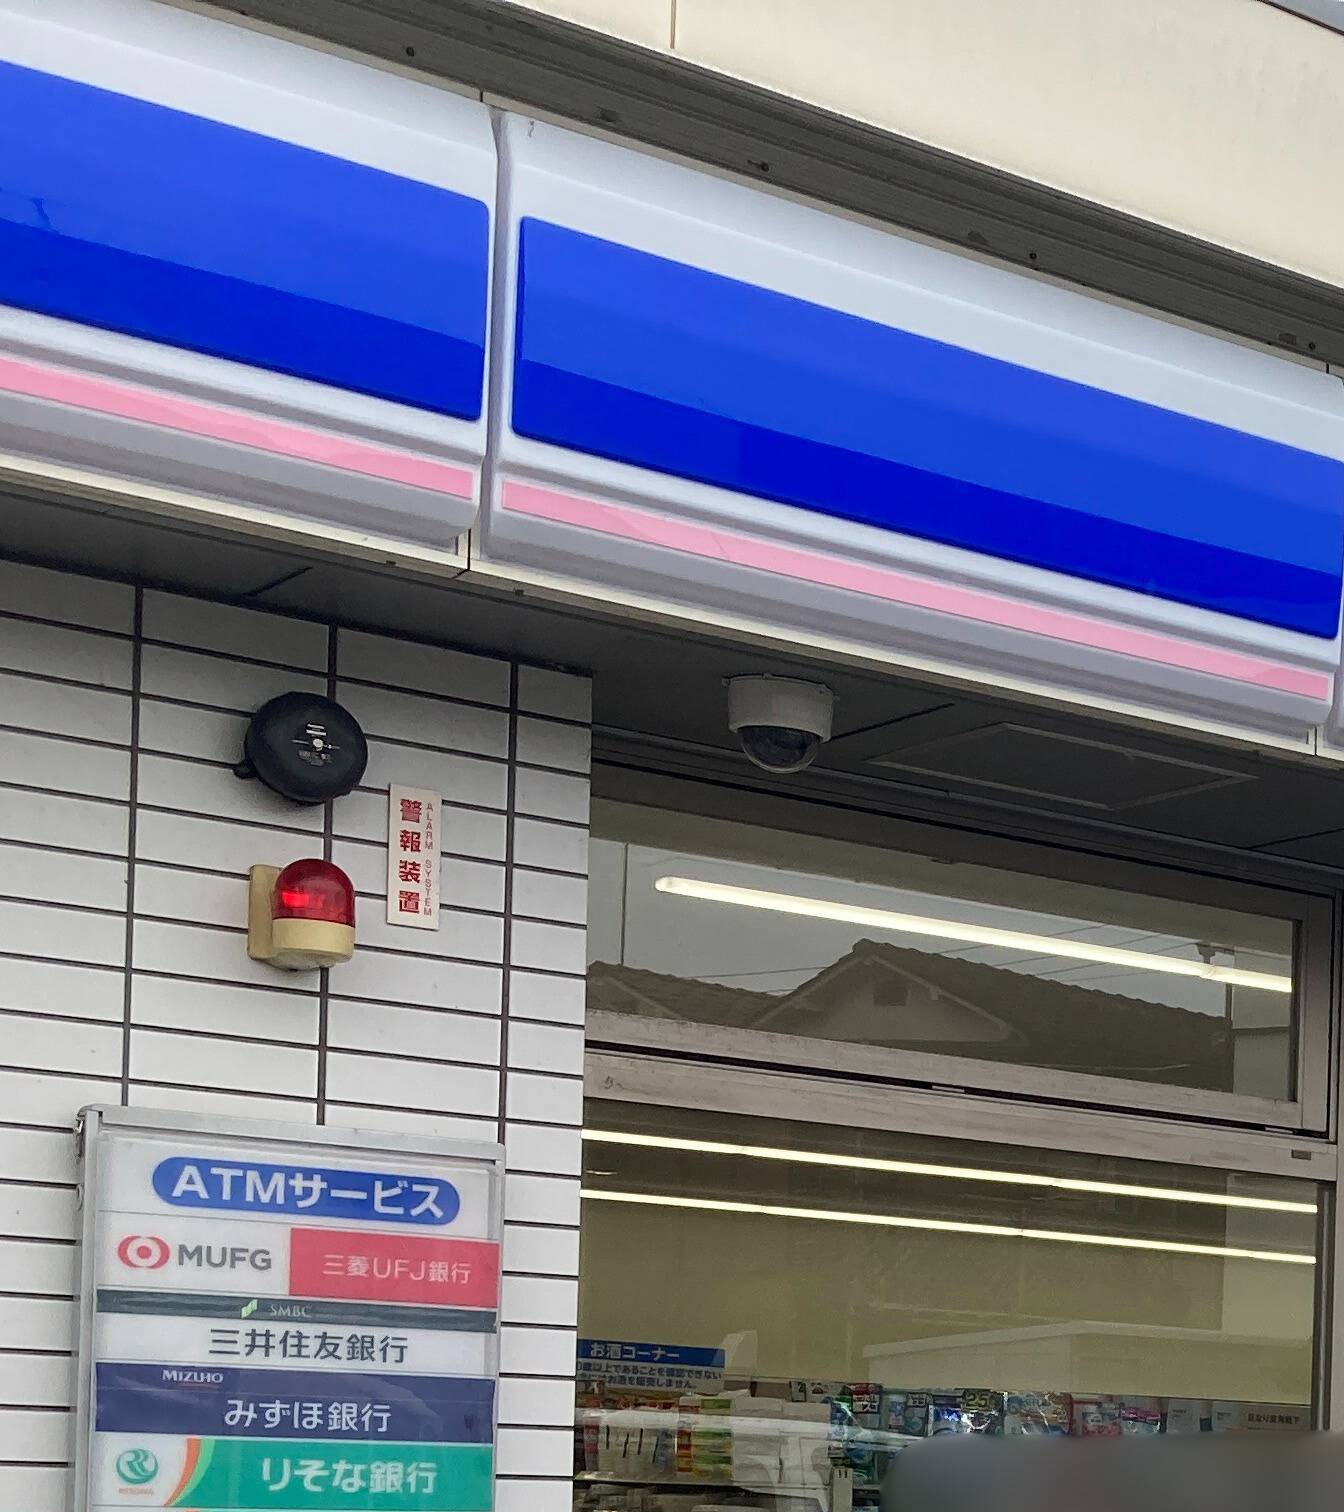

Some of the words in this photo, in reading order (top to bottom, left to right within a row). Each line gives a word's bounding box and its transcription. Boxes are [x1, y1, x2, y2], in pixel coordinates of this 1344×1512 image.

[425, 802, 433, 849] ALARM
[399, 798, 422, 914] 警報装置
[424, 859, 432, 916] SYSTEM
[172, 1164, 445, 1219] ATMサービス
[177, 1243, 273, 1271] MUFG
[322, 1254, 472, 1284] 三菱UFJ銀行
[269, 1304, 312, 1319] SMBC
[207, 1329, 409, 1364] 三井住友銀行
[590, 1343, 680, 1361] お酒コーナー
[161, 1369, 224, 1385] MIZUHO
[224, 1399, 394, 1433] みずほ銀行
[261, 1457, 438, 1495] りそな銀行
